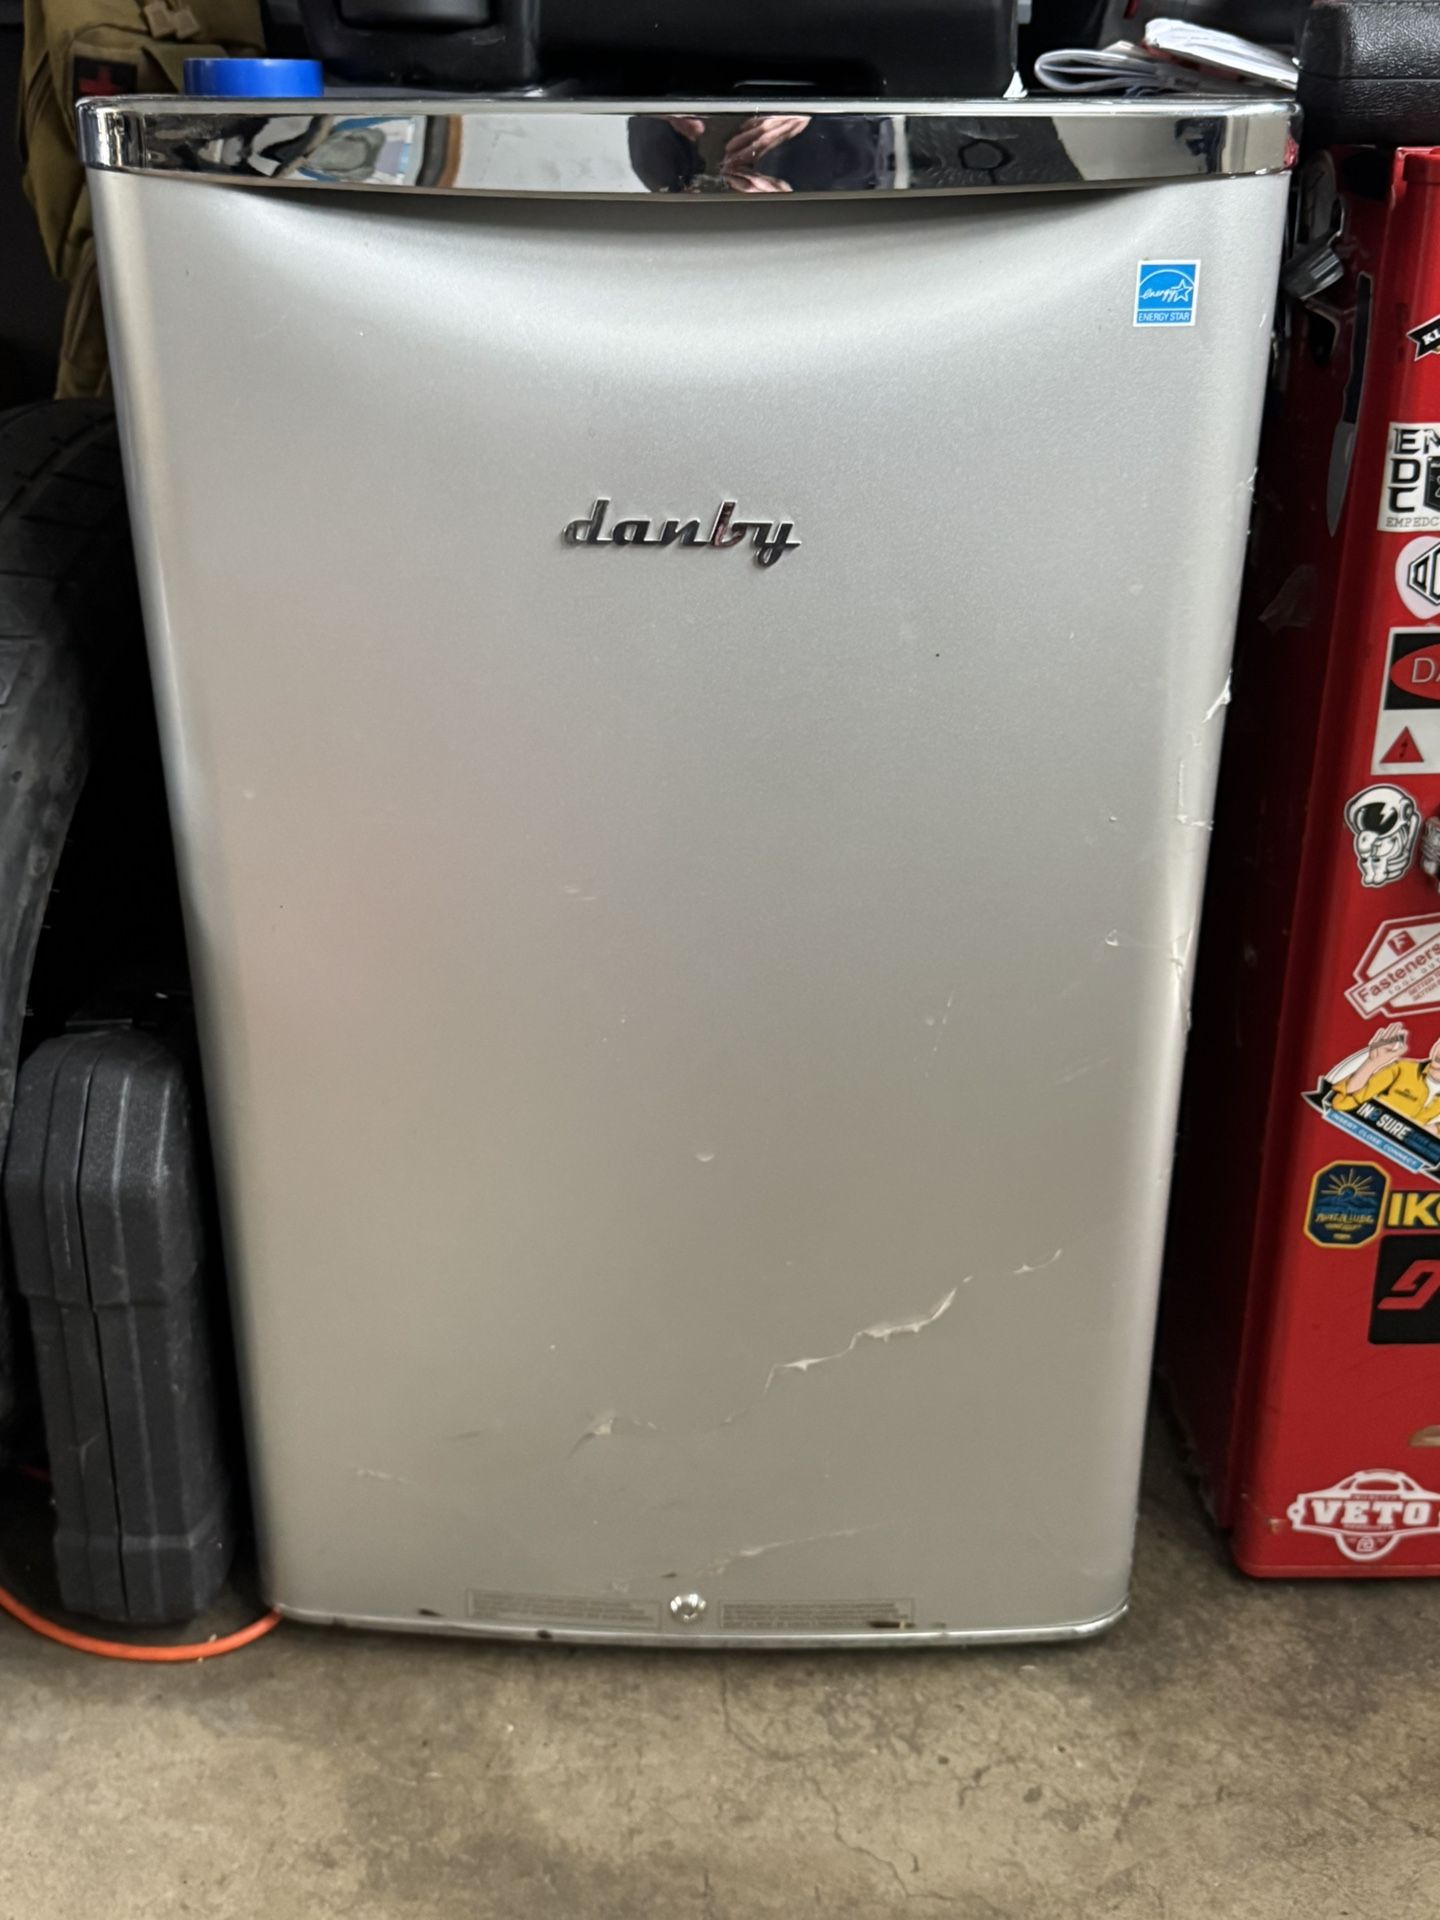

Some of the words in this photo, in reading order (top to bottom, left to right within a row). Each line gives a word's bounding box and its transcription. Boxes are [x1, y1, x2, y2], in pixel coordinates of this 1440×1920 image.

[1138, 312, 1169, 321] ENERGY
[1170, 312, 1190, 321] STAR
[562, 497, 802, 567] danby
[1357, 943, 1440, 1003] Fasteners
[1388, 1193, 1440, 1226] IK
[1311, 1500, 1431, 1525] VETO
